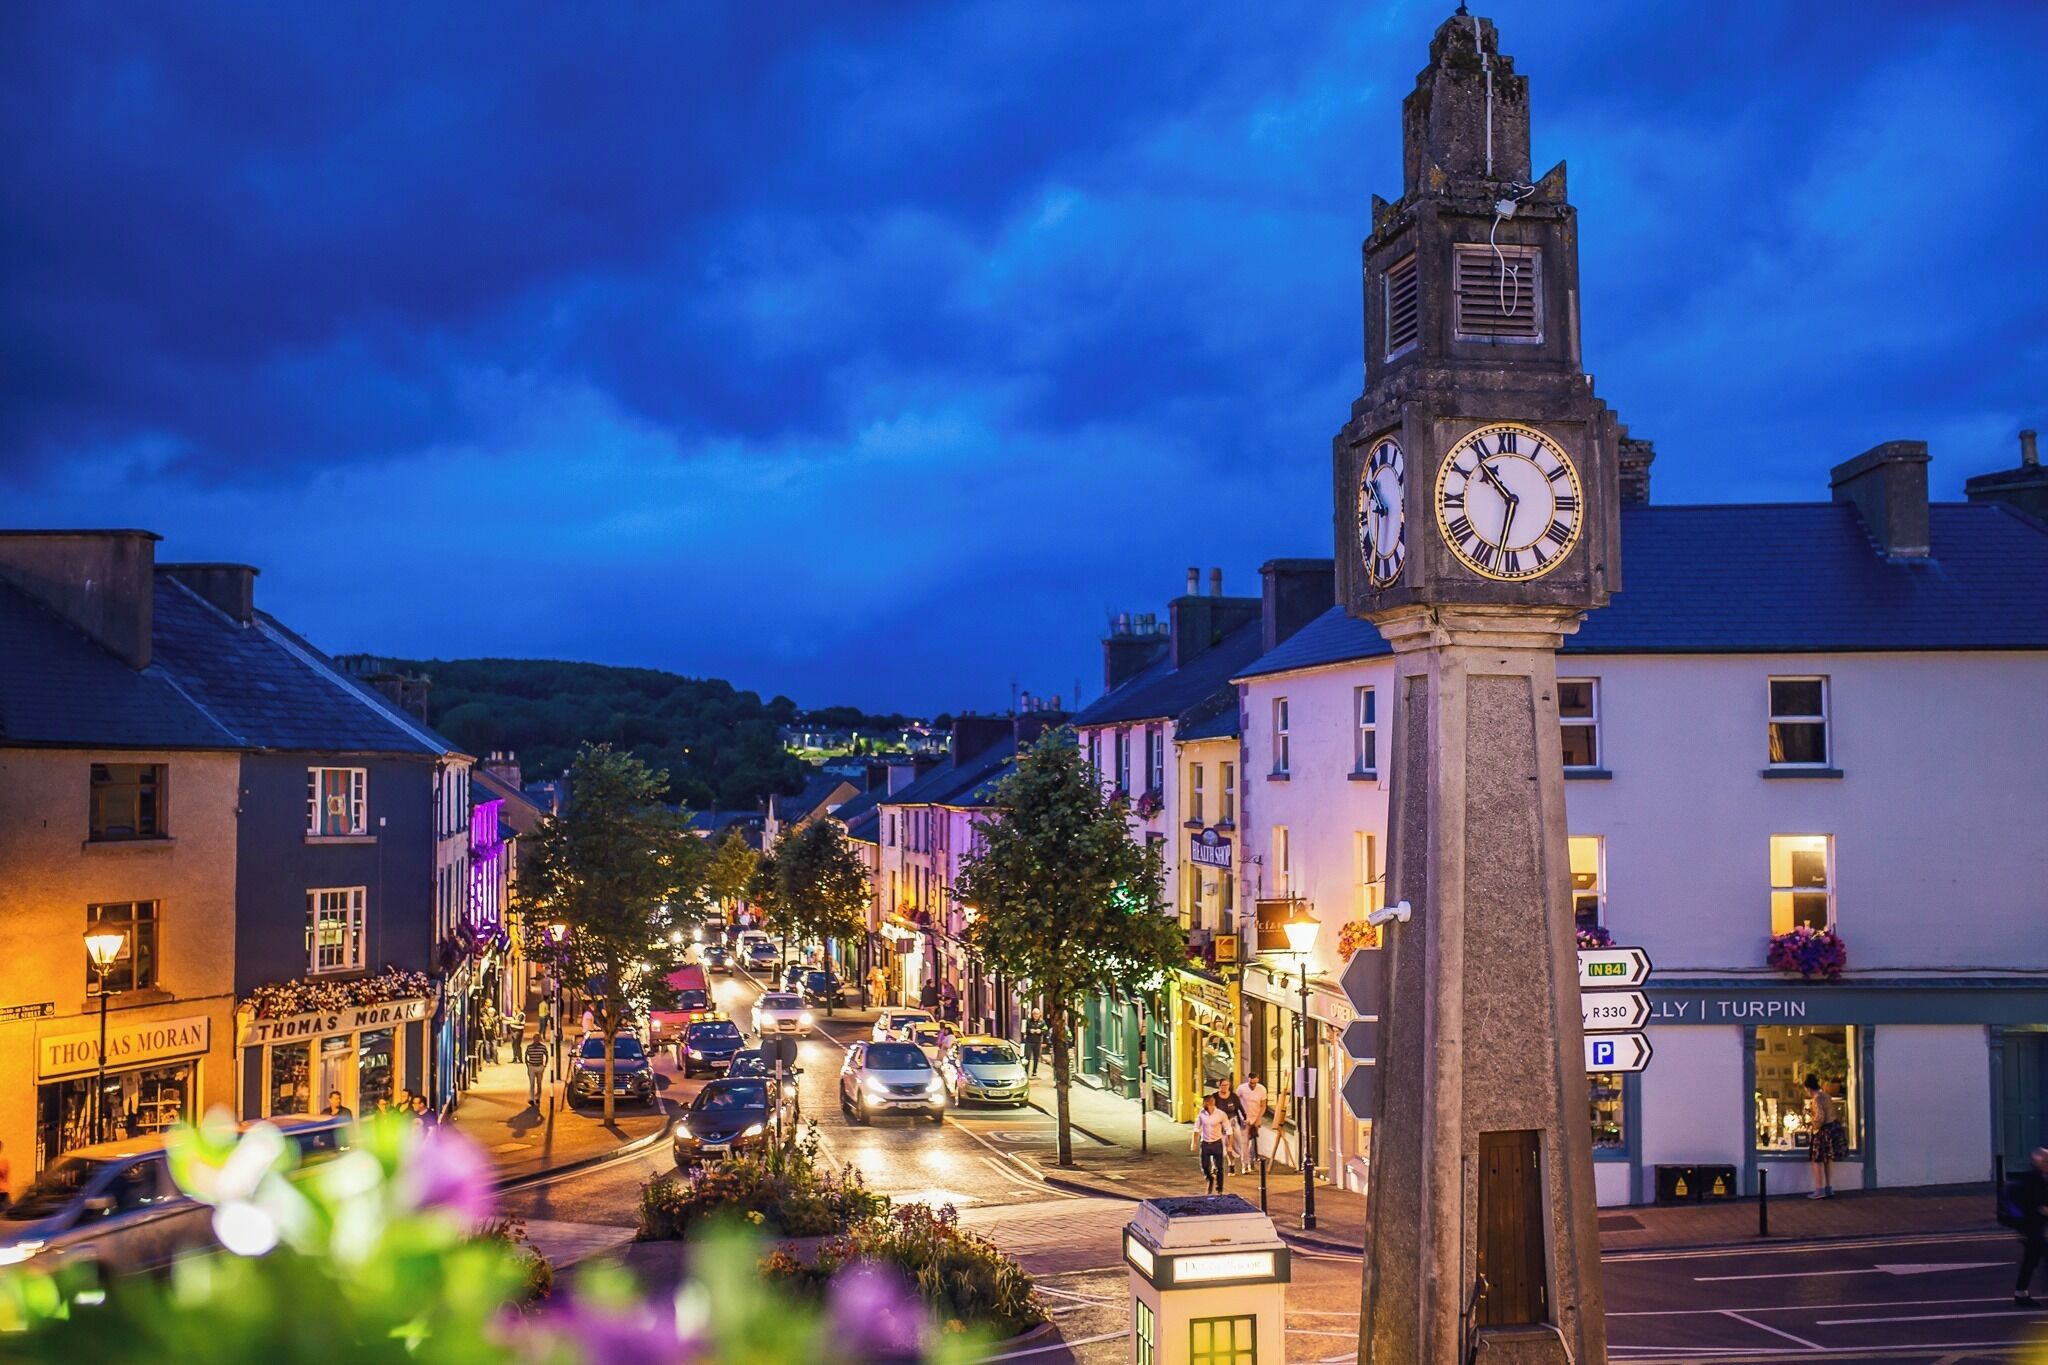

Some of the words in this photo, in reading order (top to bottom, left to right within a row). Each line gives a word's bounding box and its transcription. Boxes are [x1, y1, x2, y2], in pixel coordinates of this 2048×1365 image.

[1497, 433, 1516, 454] XII
[1192, 840, 1214, 863] HEALTH
[1215, 845, 1231, 866] SHOP
[1717, 1001, 1806, 1017] TURPIN
[258, 1016, 338, 1040] THOMAS
[355, 1003, 417, 1026] MORAN
[50, 1035, 131, 1065] THOMAS
[138, 1024, 202, 1053] MORAN
[1597, 1043, 1612, 1064] P
